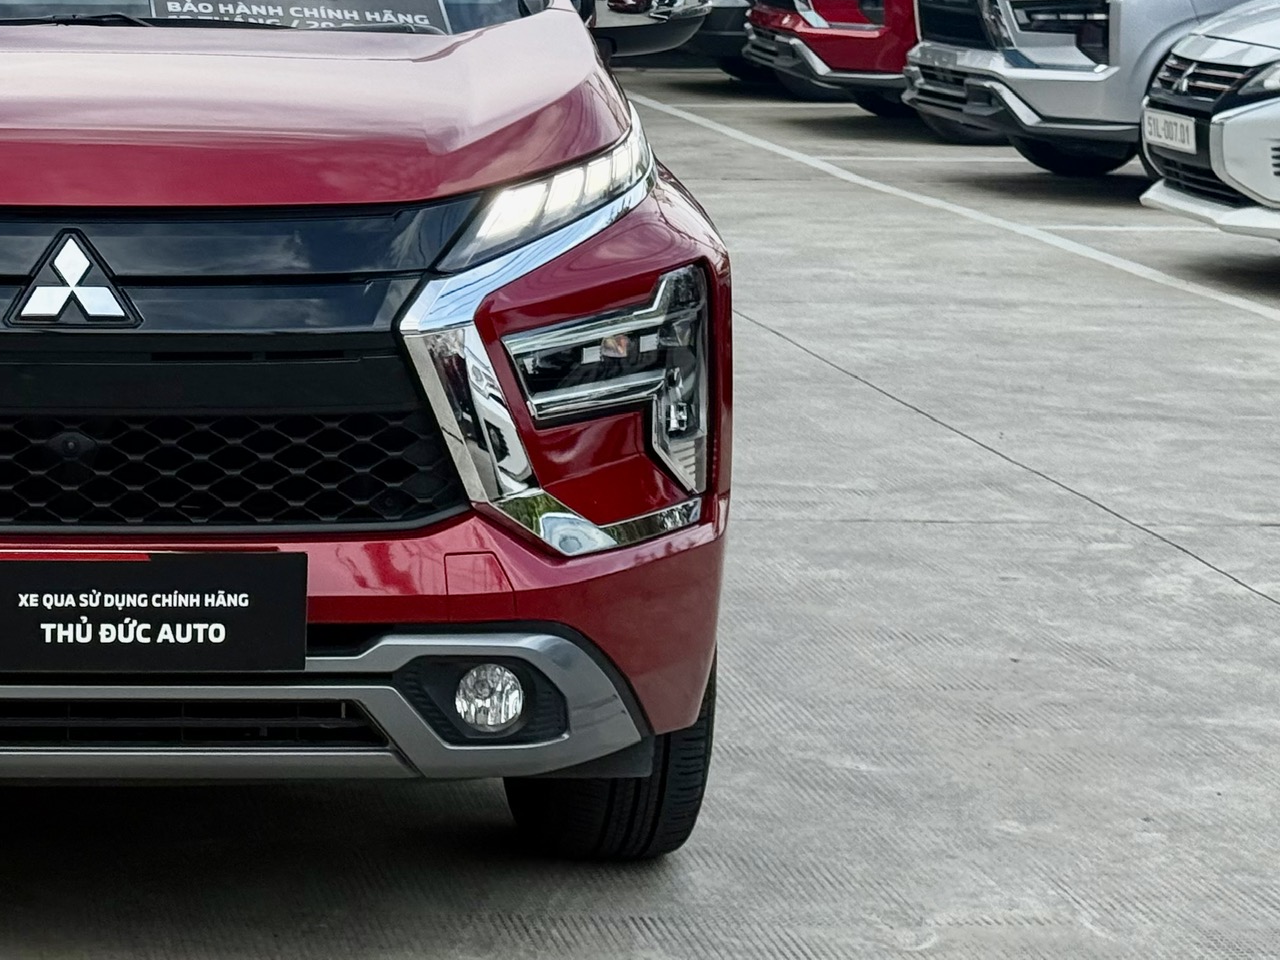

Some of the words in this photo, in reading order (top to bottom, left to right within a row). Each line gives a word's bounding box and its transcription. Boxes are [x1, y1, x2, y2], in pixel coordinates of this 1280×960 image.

[218, 2, 284, 17] HÀNH
[289, 6, 360, 20] CHÍNH
[364, 9, 431, 25] HÃNG
[18, 594, 39, 607] XE
[42, 594, 76, 609] QUA
[79, 589, 102, 607] SỬ
[104, 594, 148, 610] DỤNG
[151, 590, 200, 607] CHÍNH
[204, 590, 249, 607] HÃNG
[40, 616, 93, 643] THỦ
[99, 617, 151, 643] ĐỨC
[156, 623, 226, 643] AUTO
